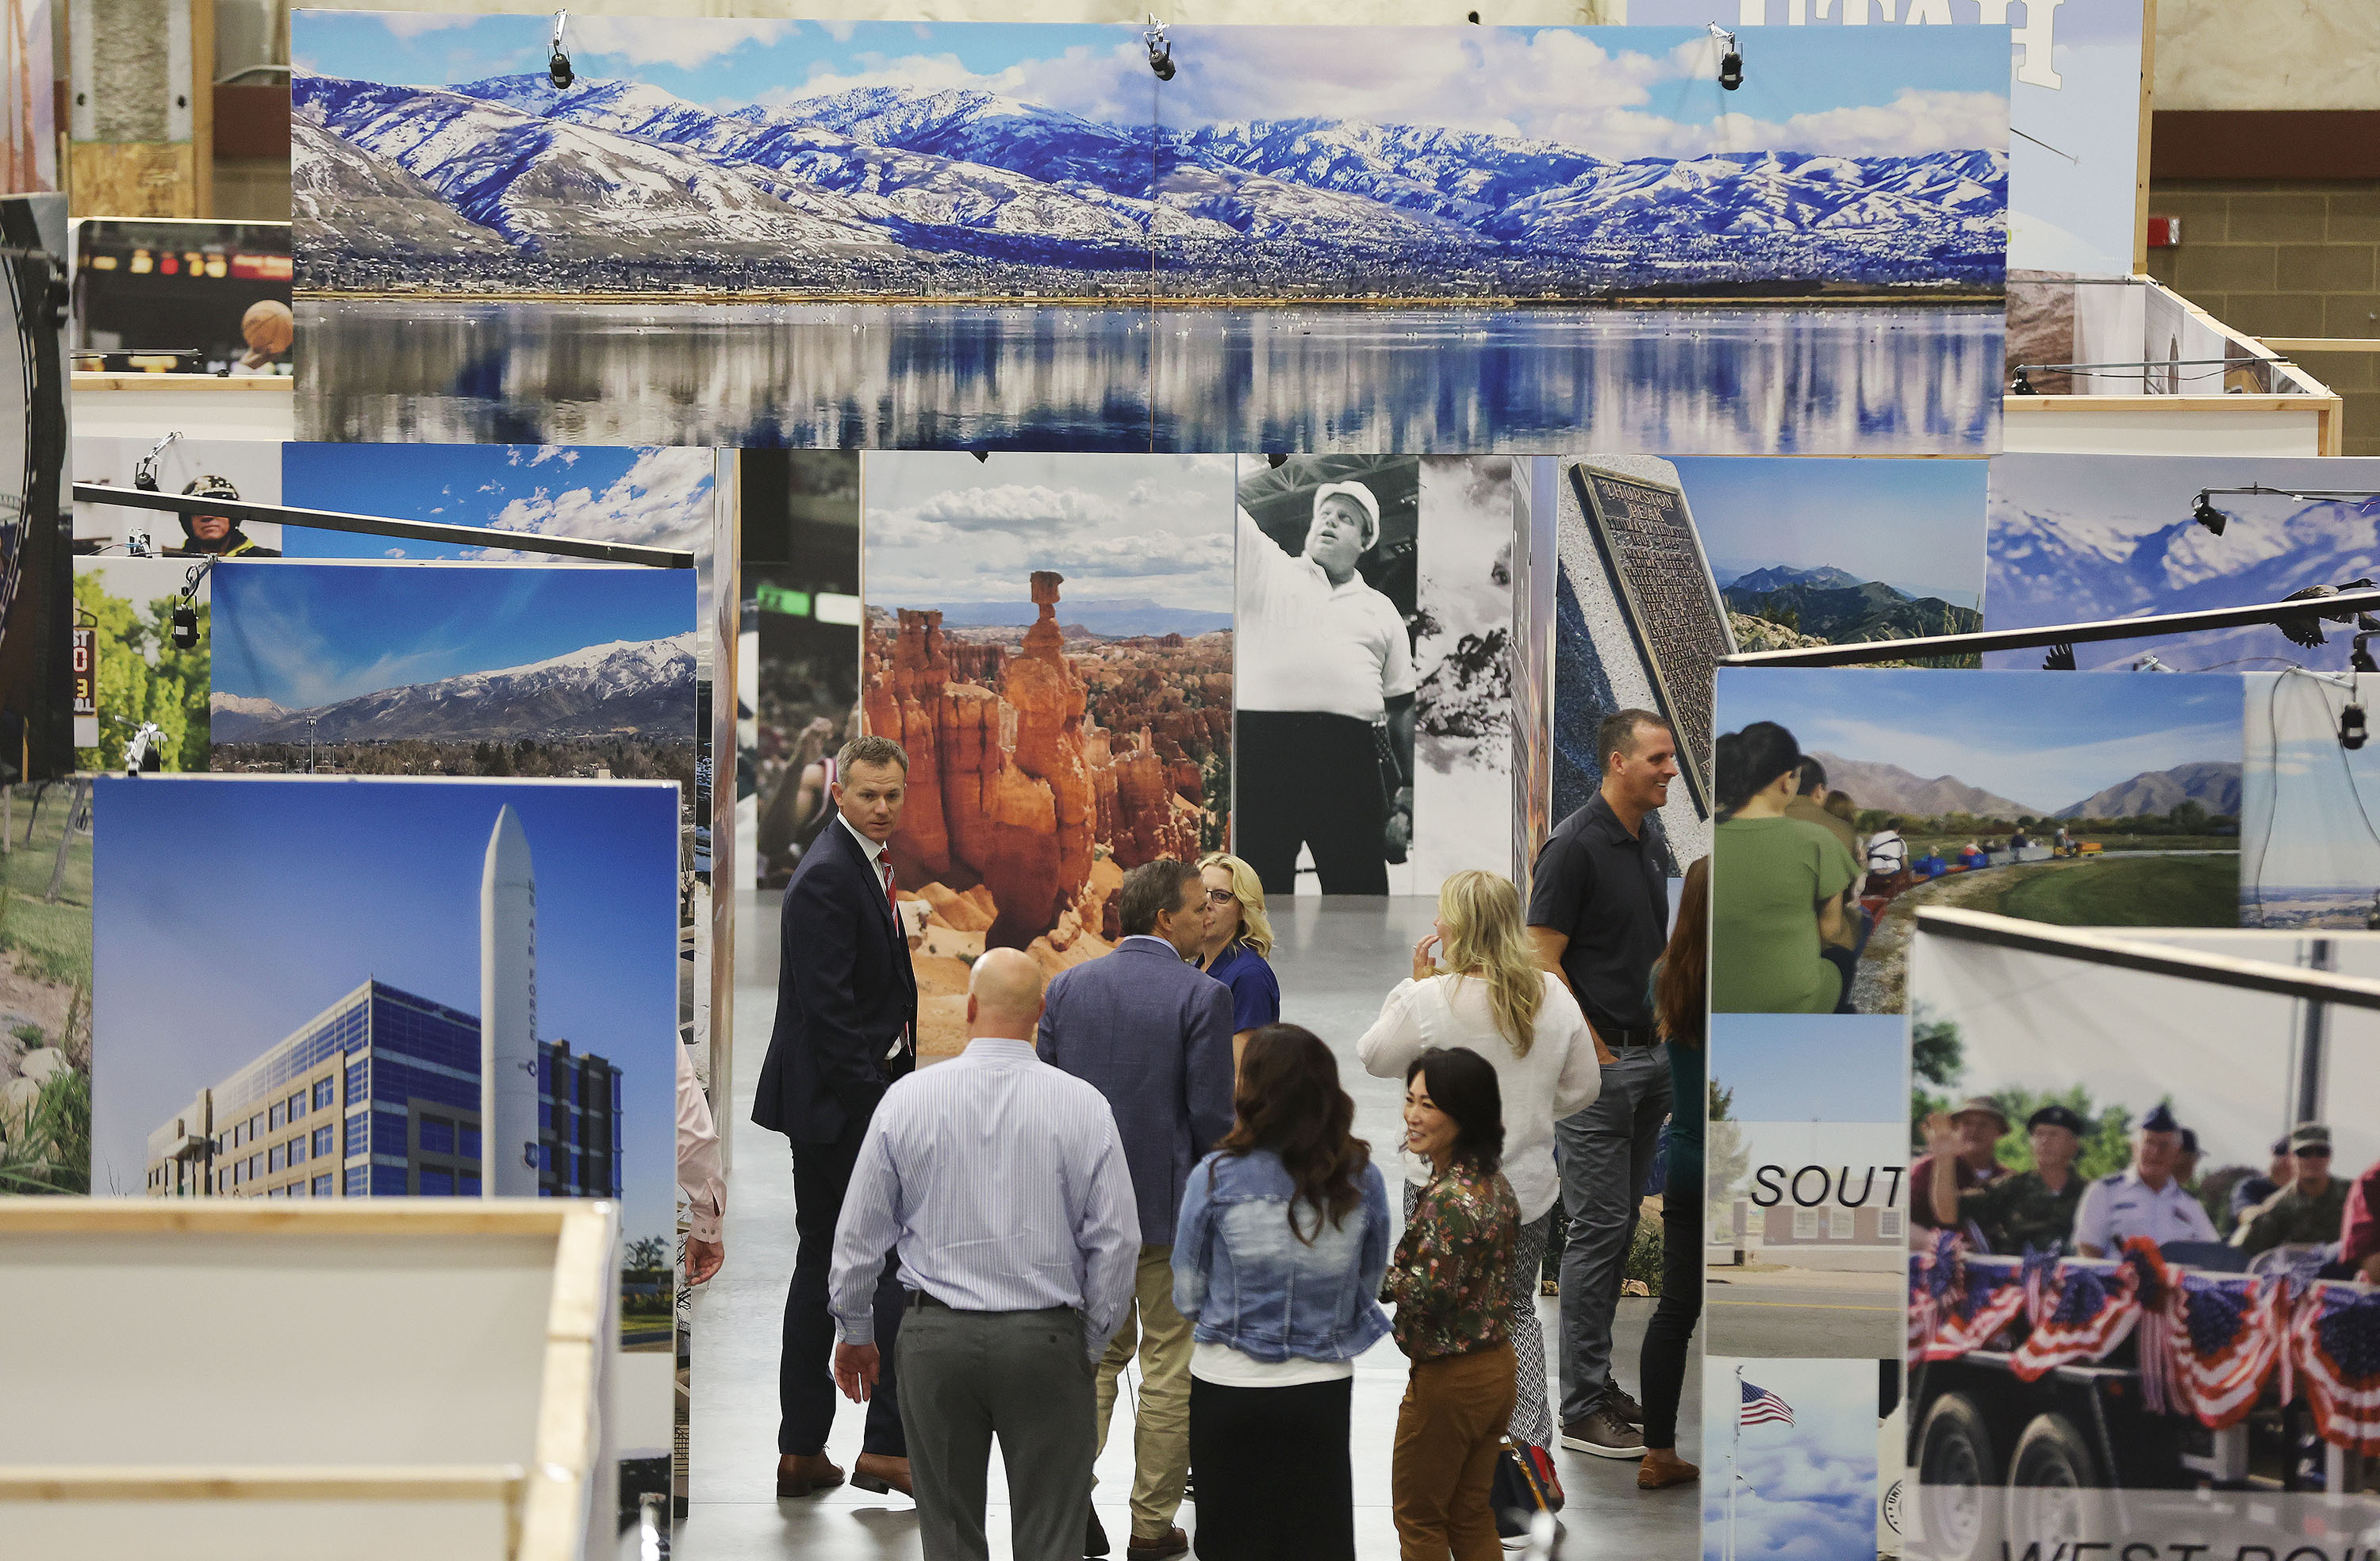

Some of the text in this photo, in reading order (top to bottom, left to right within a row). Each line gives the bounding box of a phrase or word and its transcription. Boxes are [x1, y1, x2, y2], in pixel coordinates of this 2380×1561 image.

[1599, 478, 1674, 508] THURSTON
[1626, 502, 1664, 523] PEAK
[1752, 1164, 1907, 1207] SOUT
